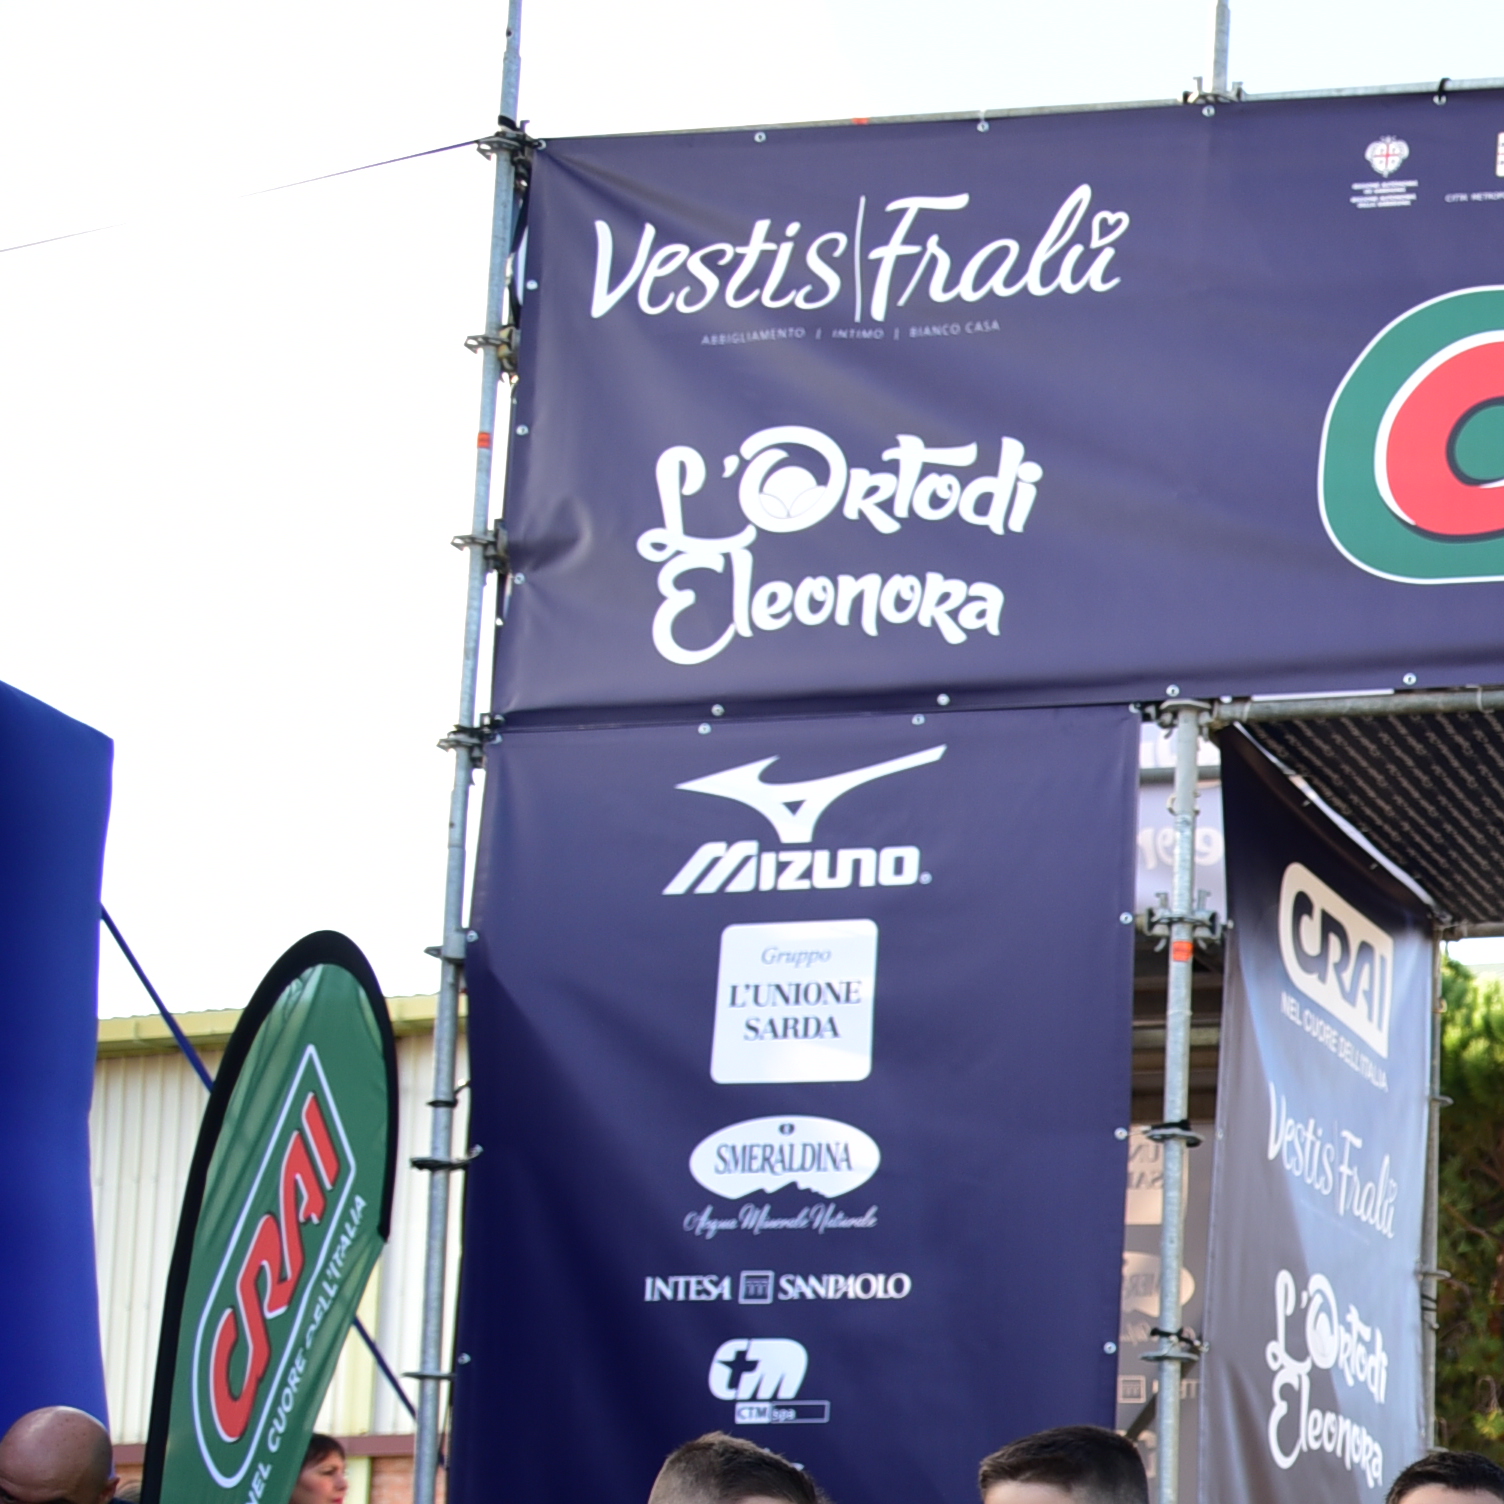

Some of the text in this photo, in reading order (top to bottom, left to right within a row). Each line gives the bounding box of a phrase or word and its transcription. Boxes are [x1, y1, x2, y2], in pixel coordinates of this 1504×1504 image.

[590, 219, 848, 319] Vestis
[701, 327, 806, 346] ABBIGLIAMENTO
[910, 324, 961, 339] BIANCO
[964, 320, 1001, 335] CASA
[651, 547, 1005, 665] Eleonora
[661, 840, 921, 895] MIZUNO
[760, 945, 832, 968] Gruppo
[1291, 886, 1389, 1040] CRAI
[728, 980, 862, 1009] L'UNIONE
[1280, 991, 1303, 1021] NEL
[743, 1015, 841, 1041] SARDA
[714, 1141, 853, 1176] SMERALDINA
[210, 1091, 340, 1444] CRAI
[644, 1272, 912, 1302] INTESA SANPAOLO
[267, 1347, 307, 1454] CUORE
[1268, 1365, 1384, 1488] Eleonora
